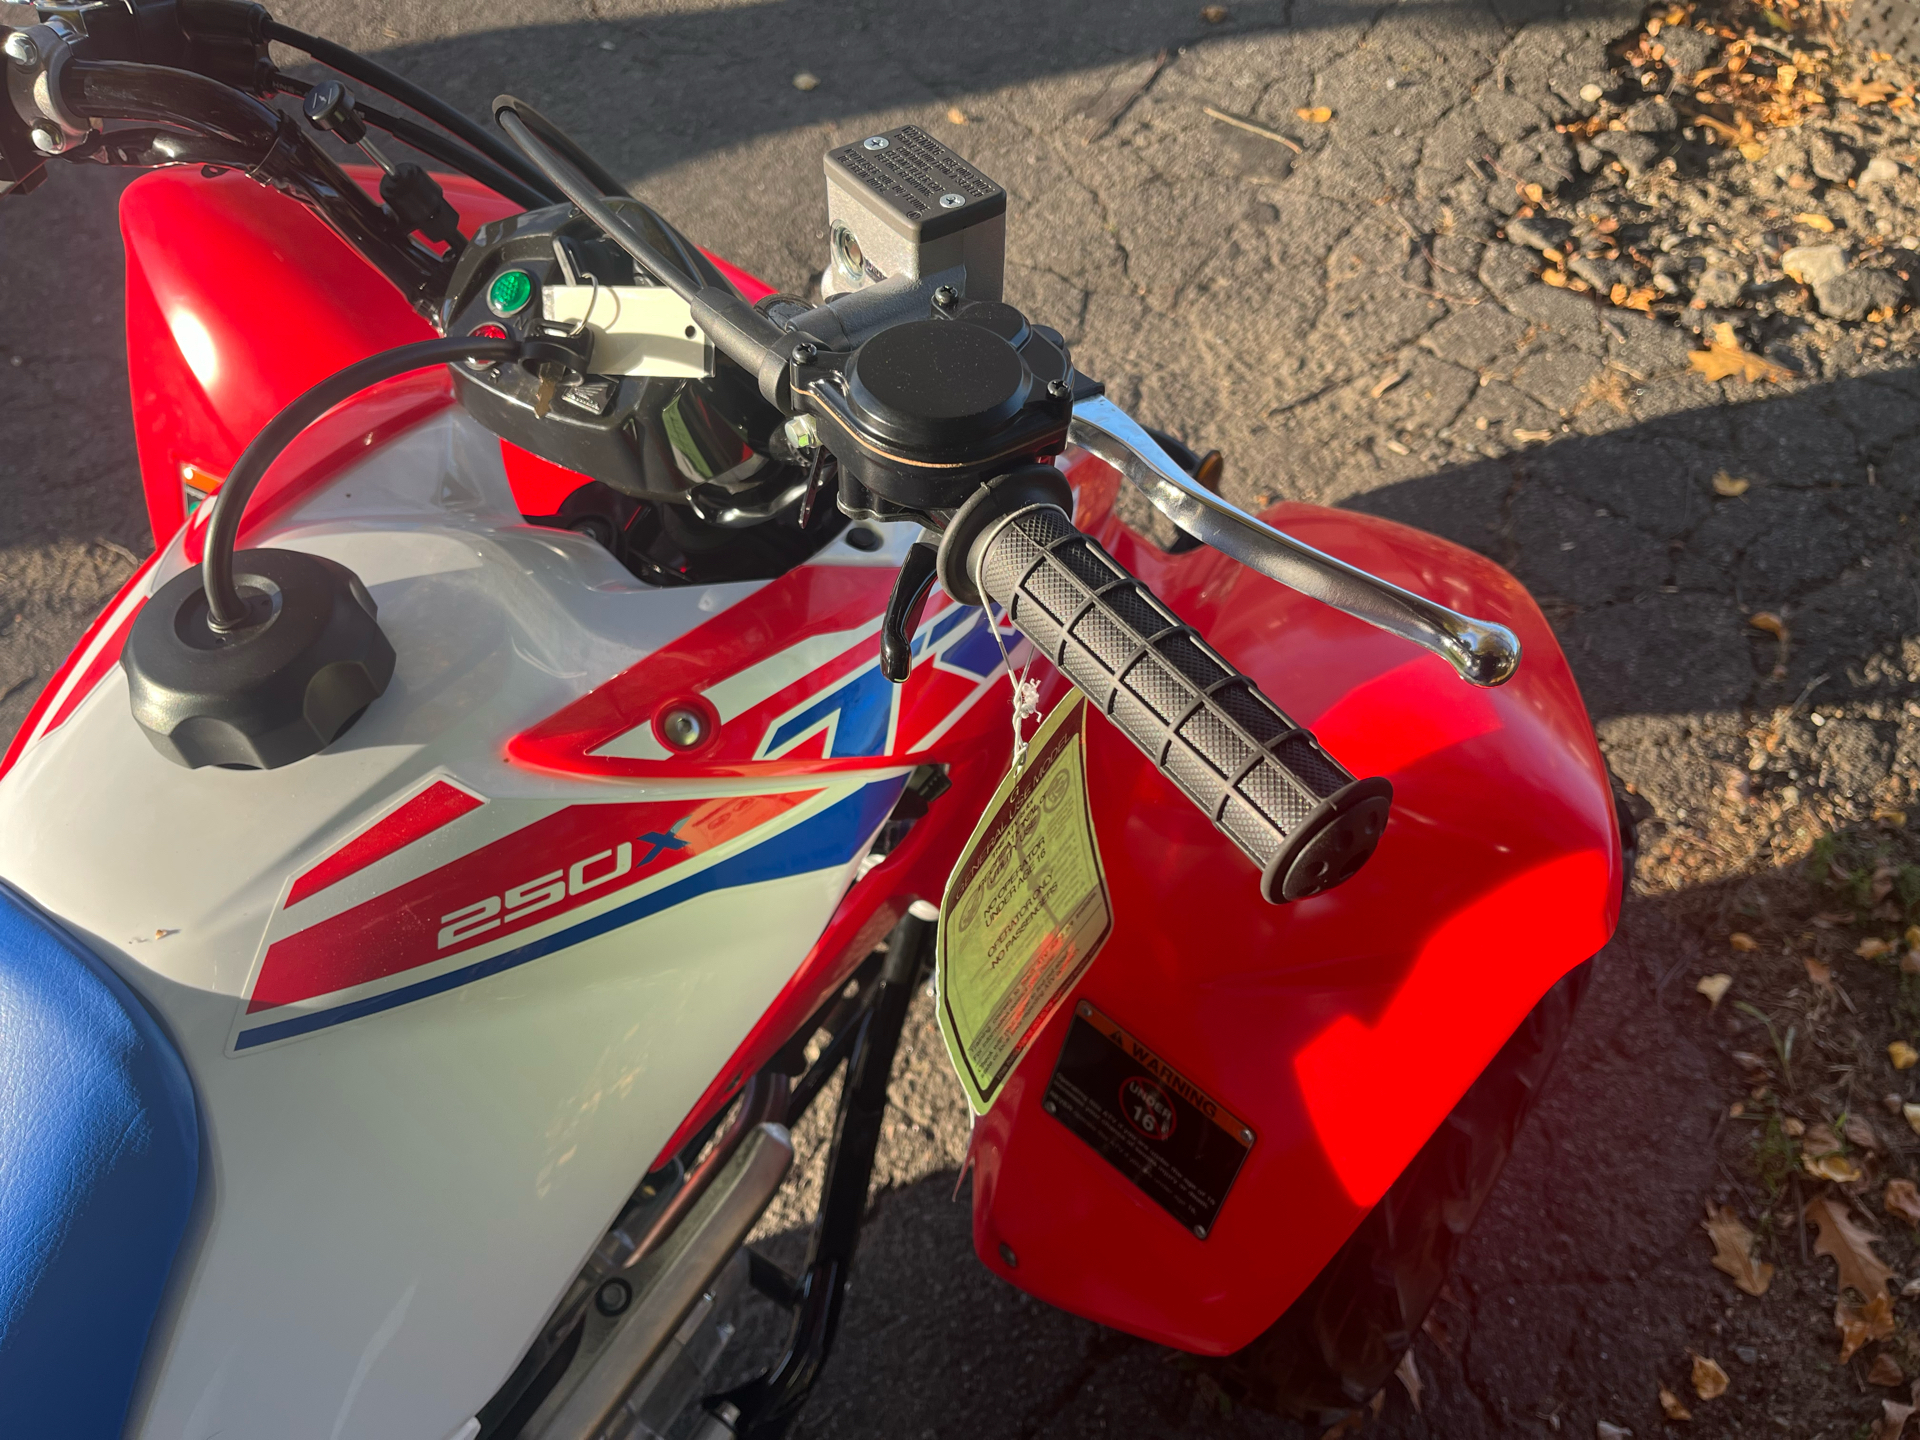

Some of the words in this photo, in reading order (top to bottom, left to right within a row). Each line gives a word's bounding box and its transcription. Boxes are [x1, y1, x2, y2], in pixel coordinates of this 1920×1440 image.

[874, 152, 903, 171] BEFORE
[884, 149, 910, 165] CLEAN
[904, 164, 933, 182] FILLER
[927, 180, 946, 192] CAP
[894, 132, 920, 148] BRAKE
[931, 160, 954, 174] FROM
[954, 177, 985, 197] SEALED
[901, 125, 946, 155] WARNING
[942, 156, 960, 167] USE
[955, 166, 977, 180] ONLY
[955, 821, 1007, 900] GENERAL
[1009, 787, 1031, 820] USE
[1033, 733, 1071, 784] MODEL
[437, 816, 691, 949] 250X
[983, 895, 997, 918] NO
[998, 835, 1045, 898] OPERATOR
[985, 884, 1015, 928] UNDER
[1018, 859, 1035, 886] AGE
[1037, 847, 1045, 863] 16
[987, 896, 1032, 957] OPERATOR
[1032, 869, 1053, 900] ONLY
[991, 946, 1005, 970] NO
[1006, 881, 1057, 950] PASSENGERS
[1128, 1080, 1172, 1121] UNDER
[1129, 1102, 1157, 1134] 16
[1130, 1042, 1218, 1118] WARNING
